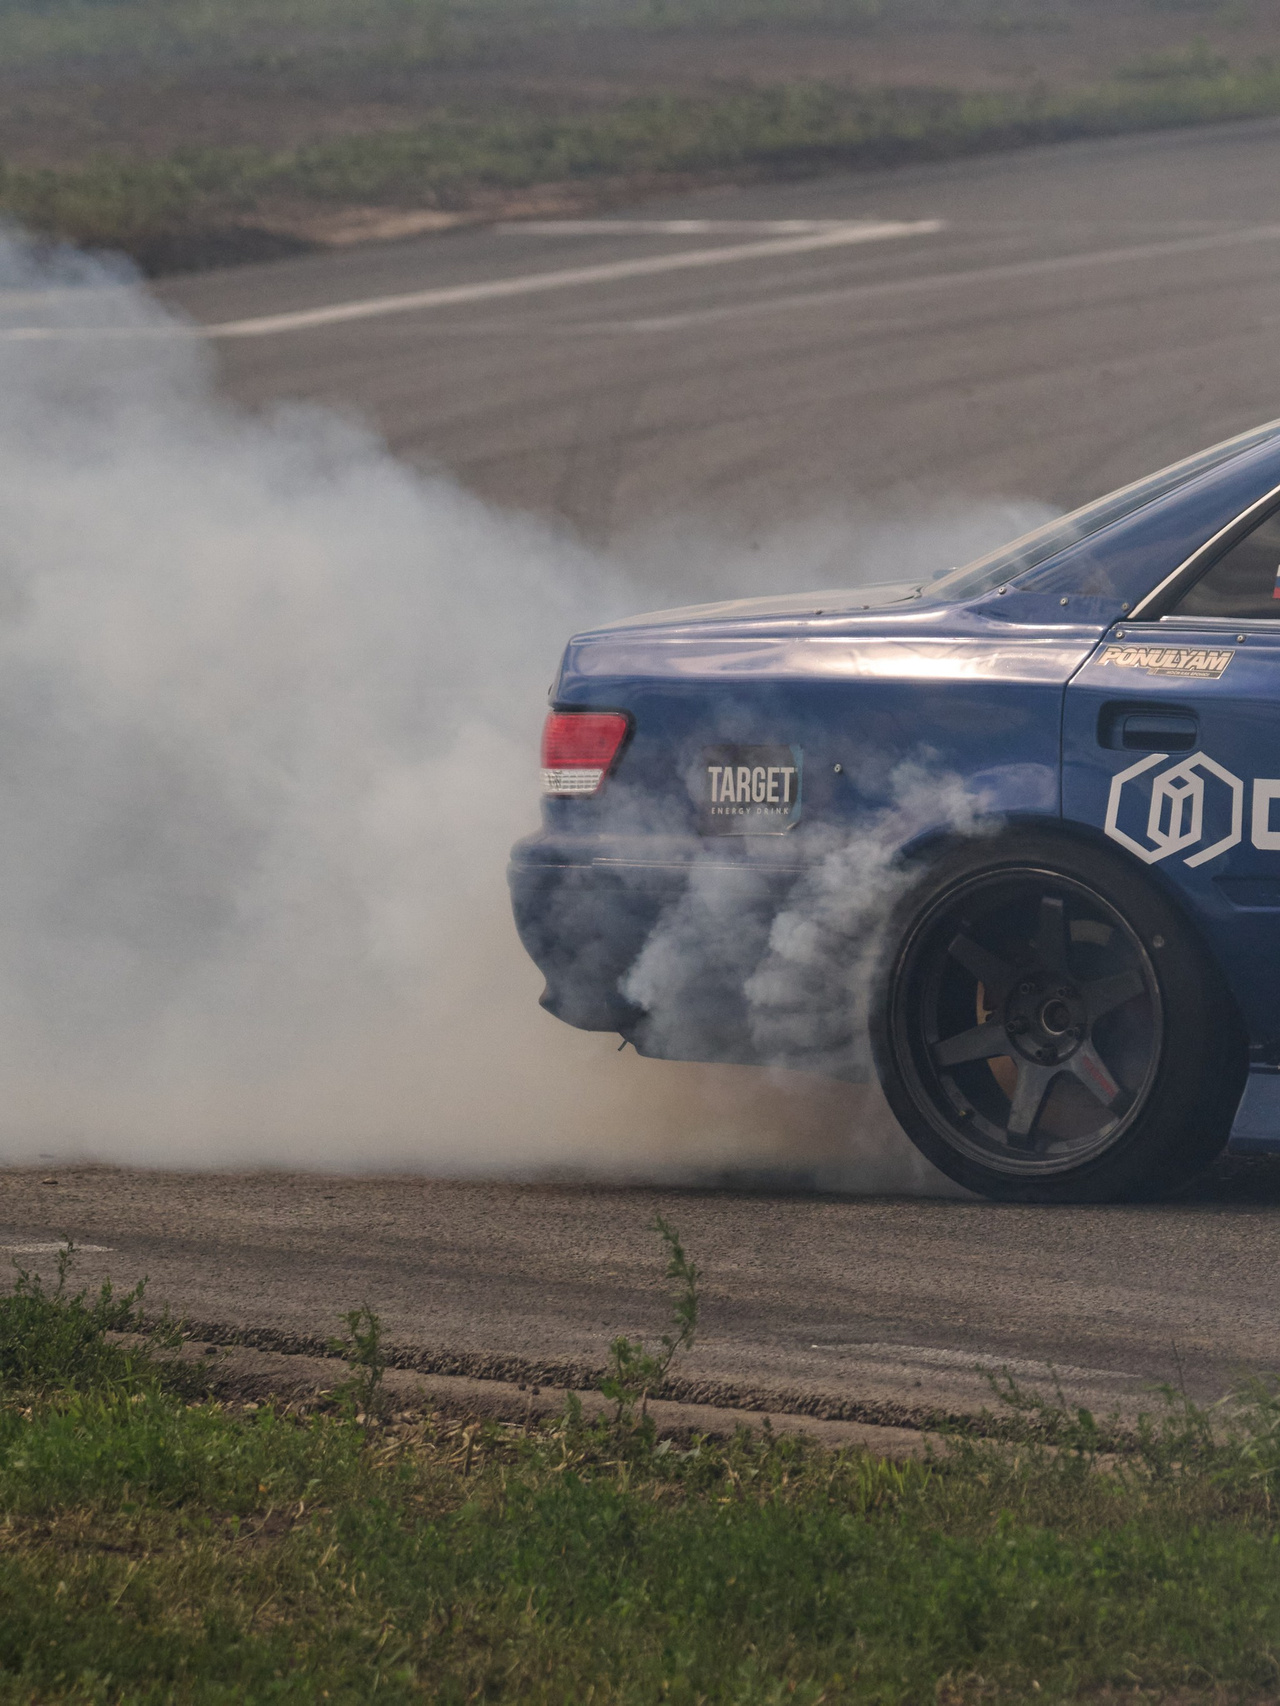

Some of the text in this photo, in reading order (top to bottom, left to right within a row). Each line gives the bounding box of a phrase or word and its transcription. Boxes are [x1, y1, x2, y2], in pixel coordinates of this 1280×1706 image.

[708, 766, 794, 803] TARGET
[711, 807, 789, 815] ENERGY DRINK
